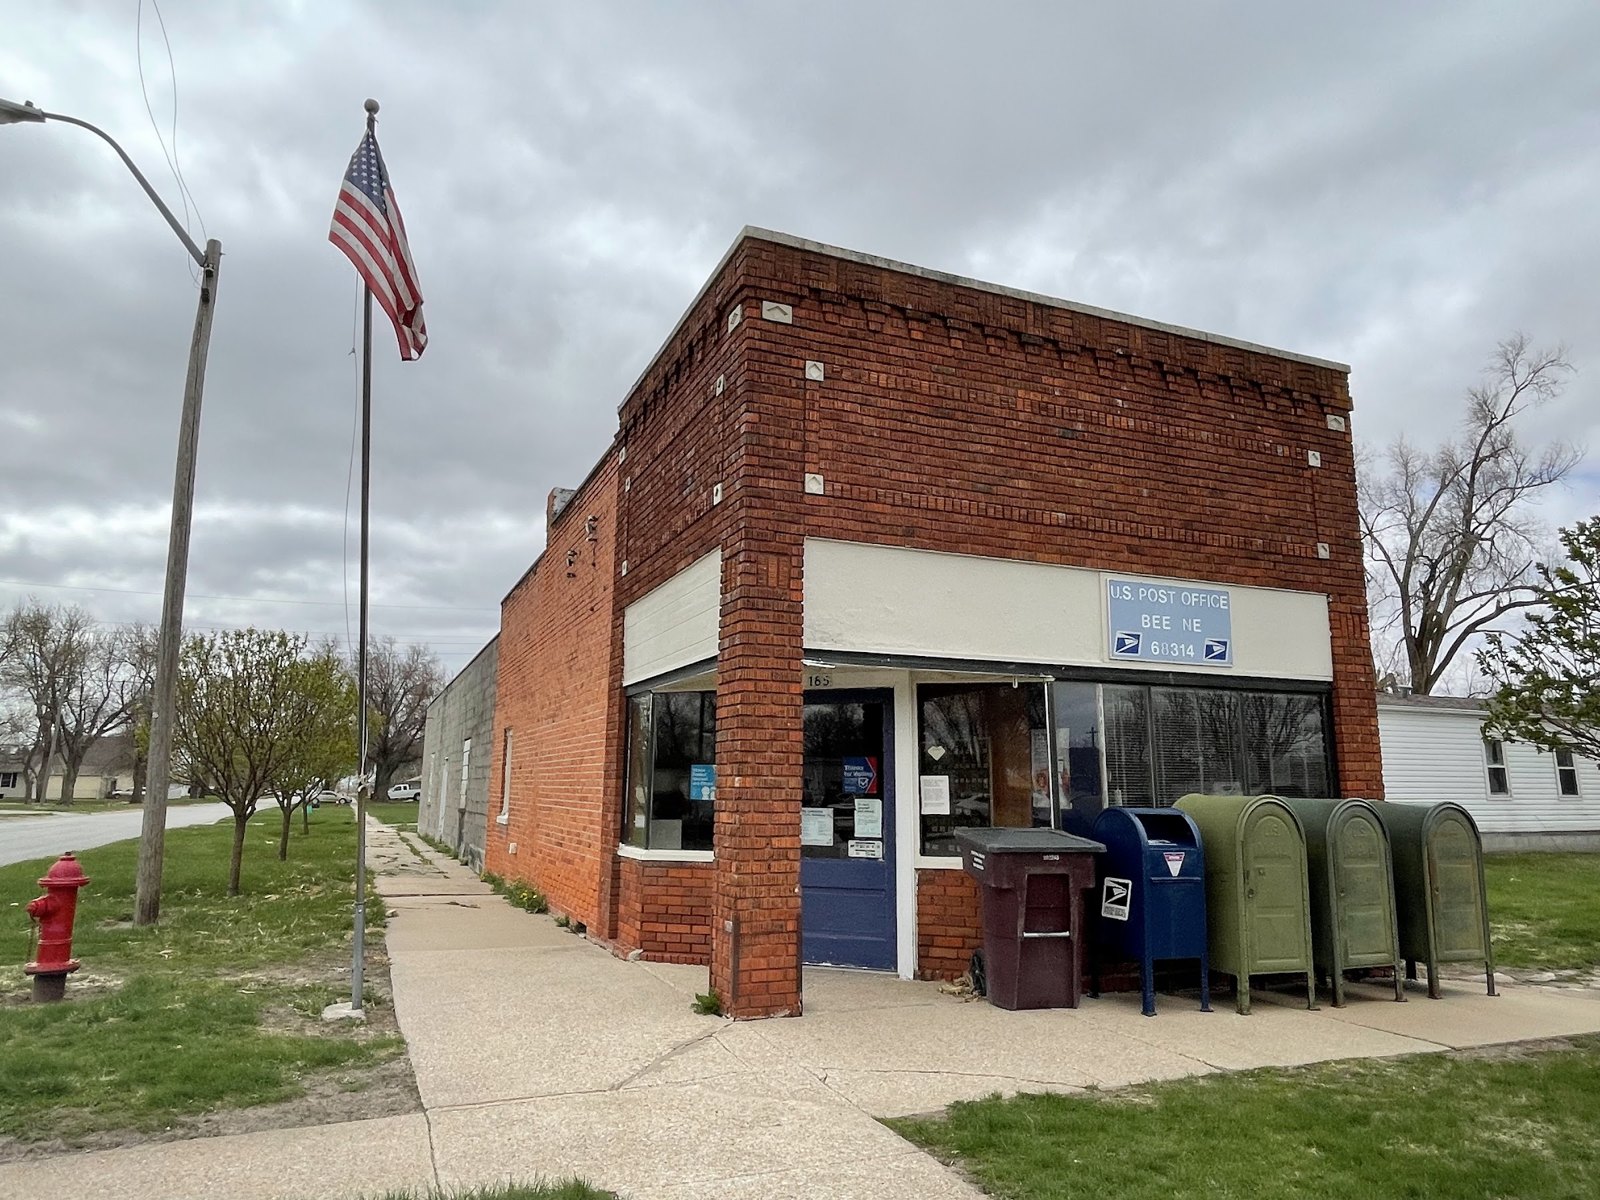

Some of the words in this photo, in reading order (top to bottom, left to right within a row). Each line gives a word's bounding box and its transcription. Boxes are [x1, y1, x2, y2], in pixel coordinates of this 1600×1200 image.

[1110, 585, 1134, 601] U.S.
[1139, 588, 1176, 604] POST
[1181, 591, 1229, 610] OFFICE
[1141, 614, 1171, 630] BEE
[1182, 618, 1202, 633] NE
[1151, 641, 1195, 658] 68314
